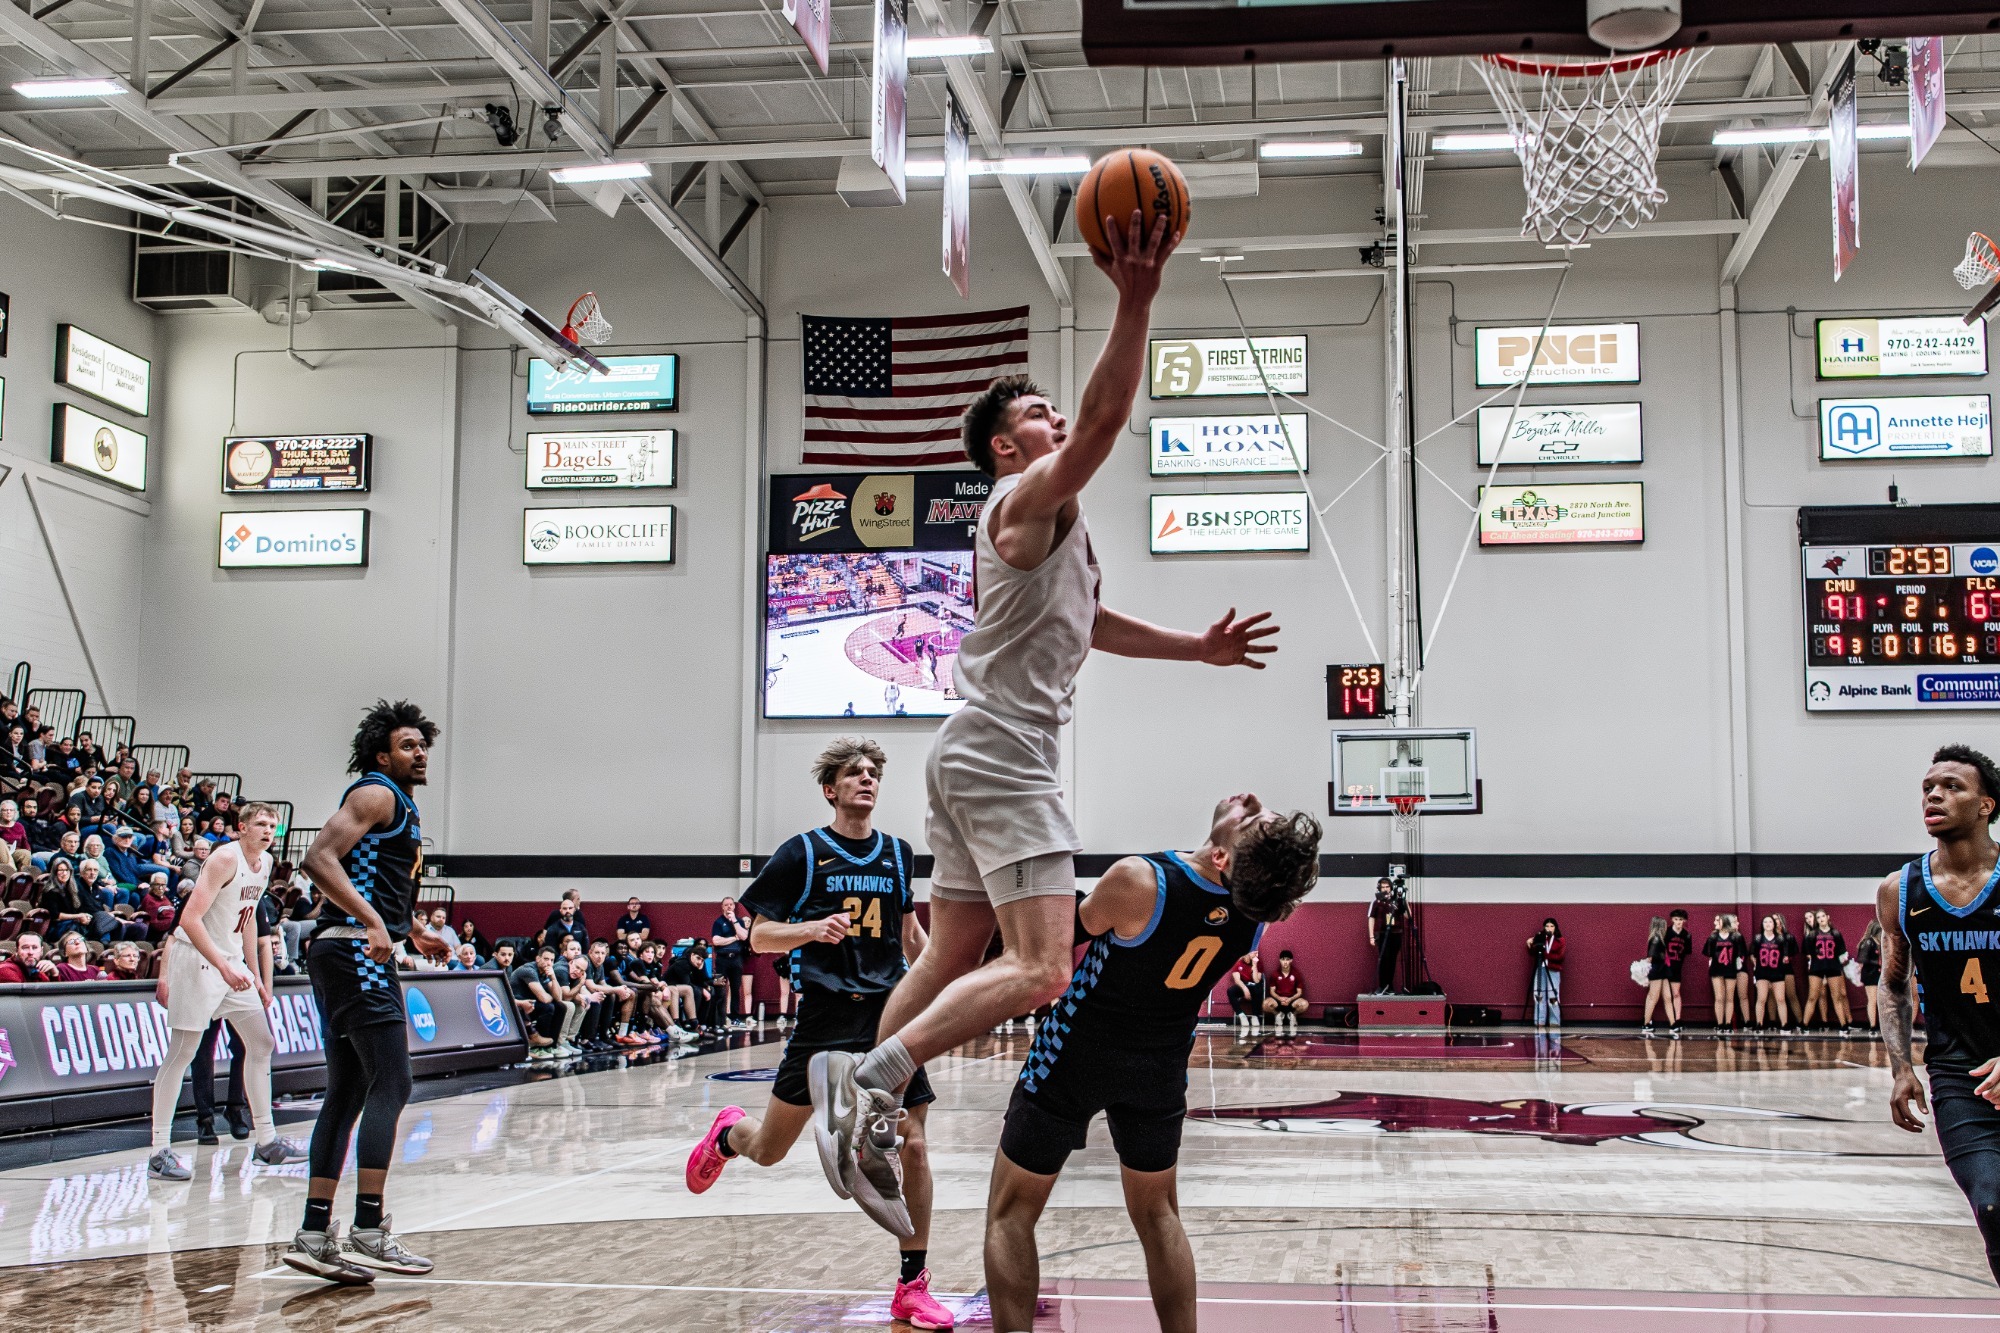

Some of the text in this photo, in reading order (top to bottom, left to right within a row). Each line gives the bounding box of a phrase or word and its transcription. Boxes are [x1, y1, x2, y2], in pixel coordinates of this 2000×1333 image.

[1887, 337, 1975, 349] 970-242-4429
[1208, 349, 1247, 365] FIRST
[1824, 355, 1879, 363] HAINING
[106, 361, 145, 385] COURTYARD
[1591, 366, 1613, 375] Inc.
[552, 402, 650, 412] RideOutrider.com
[1565, 420, 1607, 437] Miller
[1888, 414, 1988, 430] Annette Hejl
[1202, 423, 1289, 436] HOME
[1887, 431, 1955, 441] PROPERTIES
[275, 439, 357, 451] 970-248-2222
[563, 440, 628, 449] MAIN STREET
[1206, 440, 1285, 453] LOAN
[281, 449, 351, 459] THUR. FRI. SAT.
[543, 441, 612, 472] Bagels
[281, 457, 350, 467] 9:00PM-3:00AM
[1157, 457, 1266, 468] BANKING INSURANCE
[269, 478, 290, 488] BUD
[955, 482, 989, 496] Made
[792, 498, 846, 525] Pizza
[1503, 506, 1558, 521] TEXAS
[1570, 511, 1631, 519] Grand Junction
[801, 513, 841, 535] Hut
[859, 517, 911, 529] WingStreet
[565, 524, 669, 540] BOOKCLIFF
[1189, 528, 1205, 536] THE
[1208, 528, 1237, 536] HEART
[1274, 527, 1300, 535] GAME
[1490, 532, 1509, 540] Call
[1509, 531, 1538, 539] Ahead
[1539, 530, 1575, 540] Seating!
[255, 532, 356, 554] Domino's
[617, 540, 655, 548] DENTAL
[1889, 547, 1949, 574] 2:53
[1973, 558, 1999, 568] NCAA
[1825, 580, 1856, 592] CMU
[1896, 585, 1926, 594] PERIOD
[1966, 577, 1996, 591] FLC
[1827, 594, 1864, 620] 91
[1905, 596, 1919, 618] 2
[1813, 624, 1841, 634] FOULS
[1873, 623, 1949, 633] PLYR FOUL PTS
[1829, 636, 1843, 655] 9
[1852, 638, 1862, 654] 3
[1885, 635, 1899, 657] 0
[1936, 635, 1956, 656] 16
[1966, 638, 1976, 653] 3
[1848, 656, 1865, 664] T.O.L.
[1962, 655, 1980, 663] T.O.L.
[1342, 668, 1381, 686] 2:53
[1922, 675, 1999, 691] Communi
[1839, 685, 1912, 698] Alpine Bank
[1956, 691, 2000, 699] HOSPITA
[1344, 688, 1374, 713] 14
[826, 875, 894, 893] SKYHAWKS
[233, 905, 255, 933] 10
[843, 896, 882, 938] 24
[1918, 930, 2000, 952] SKYHAWK
[1815, 940, 1836, 960] 38
[1164, 935, 1223, 990] 0
[1960, 957, 1990, 1004] 4
[413, 1012, 436, 1029] NCAA
